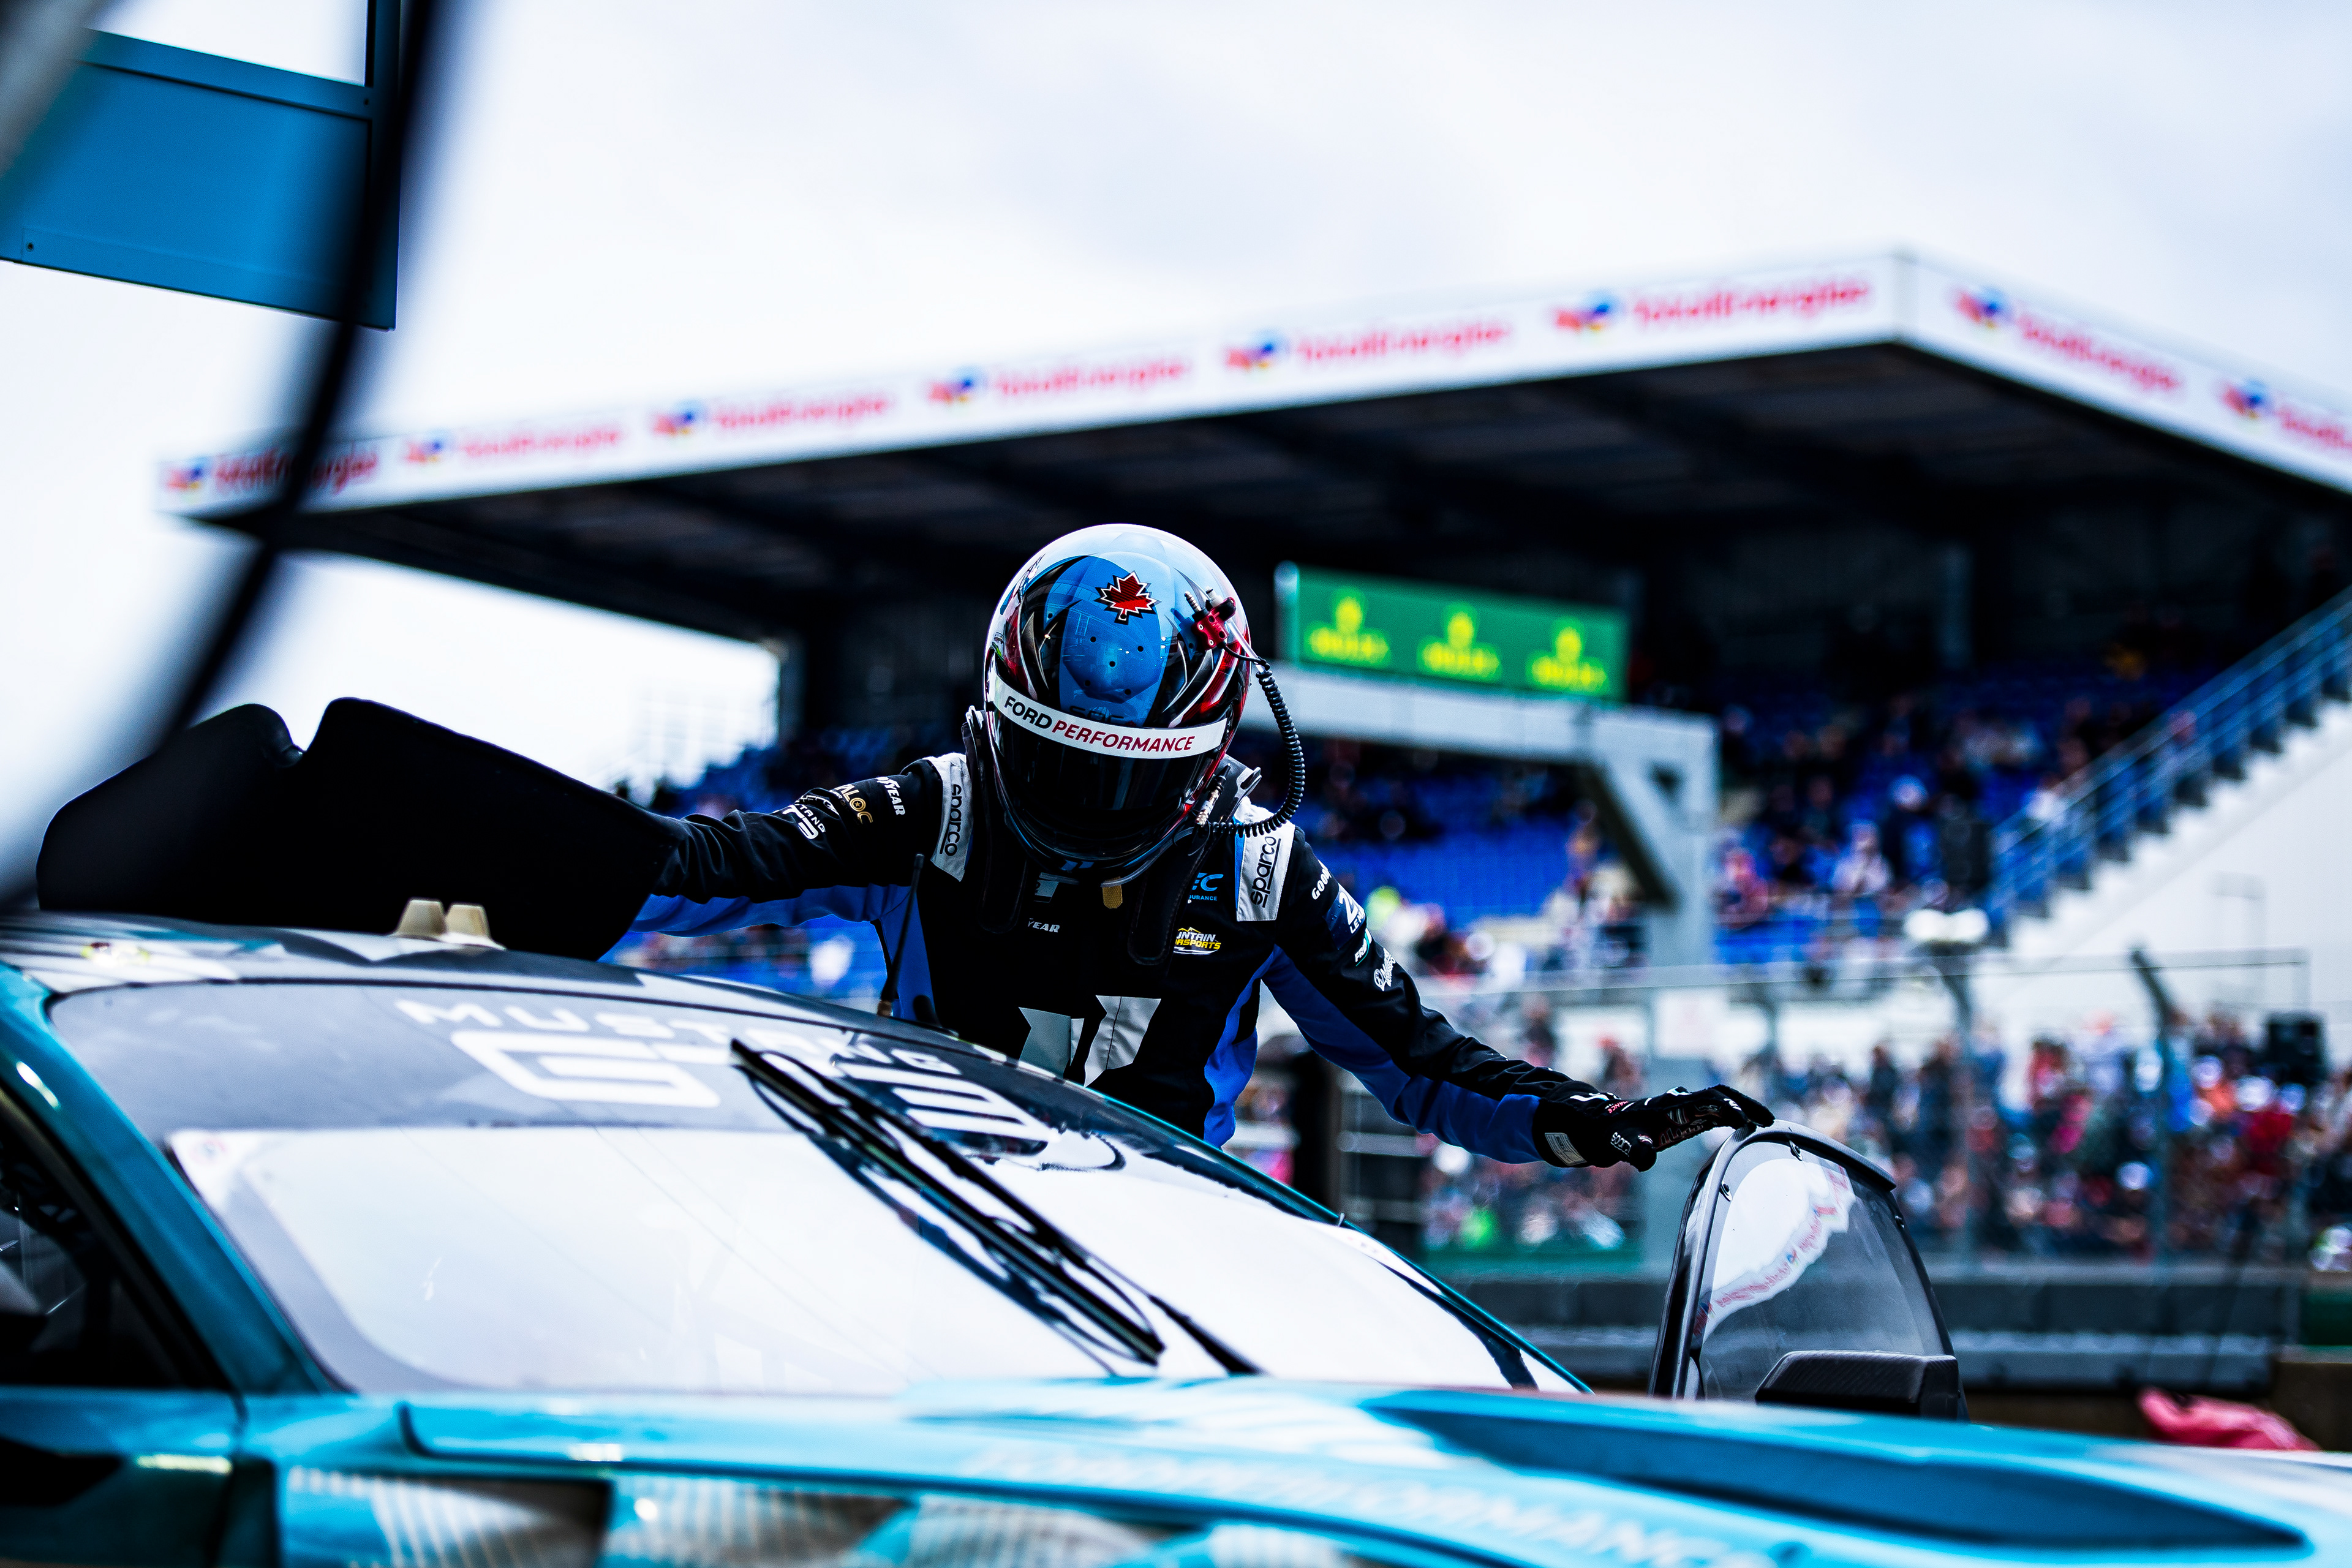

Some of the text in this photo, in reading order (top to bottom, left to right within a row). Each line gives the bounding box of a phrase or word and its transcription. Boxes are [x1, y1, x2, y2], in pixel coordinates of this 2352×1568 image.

[1004, 696, 1052, 729] FORD
[1052, 720, 1195, 752] PERFORMANCE
[940, 784, 962, 856] sparco
[1250, 836, 1281, 908] sparco
